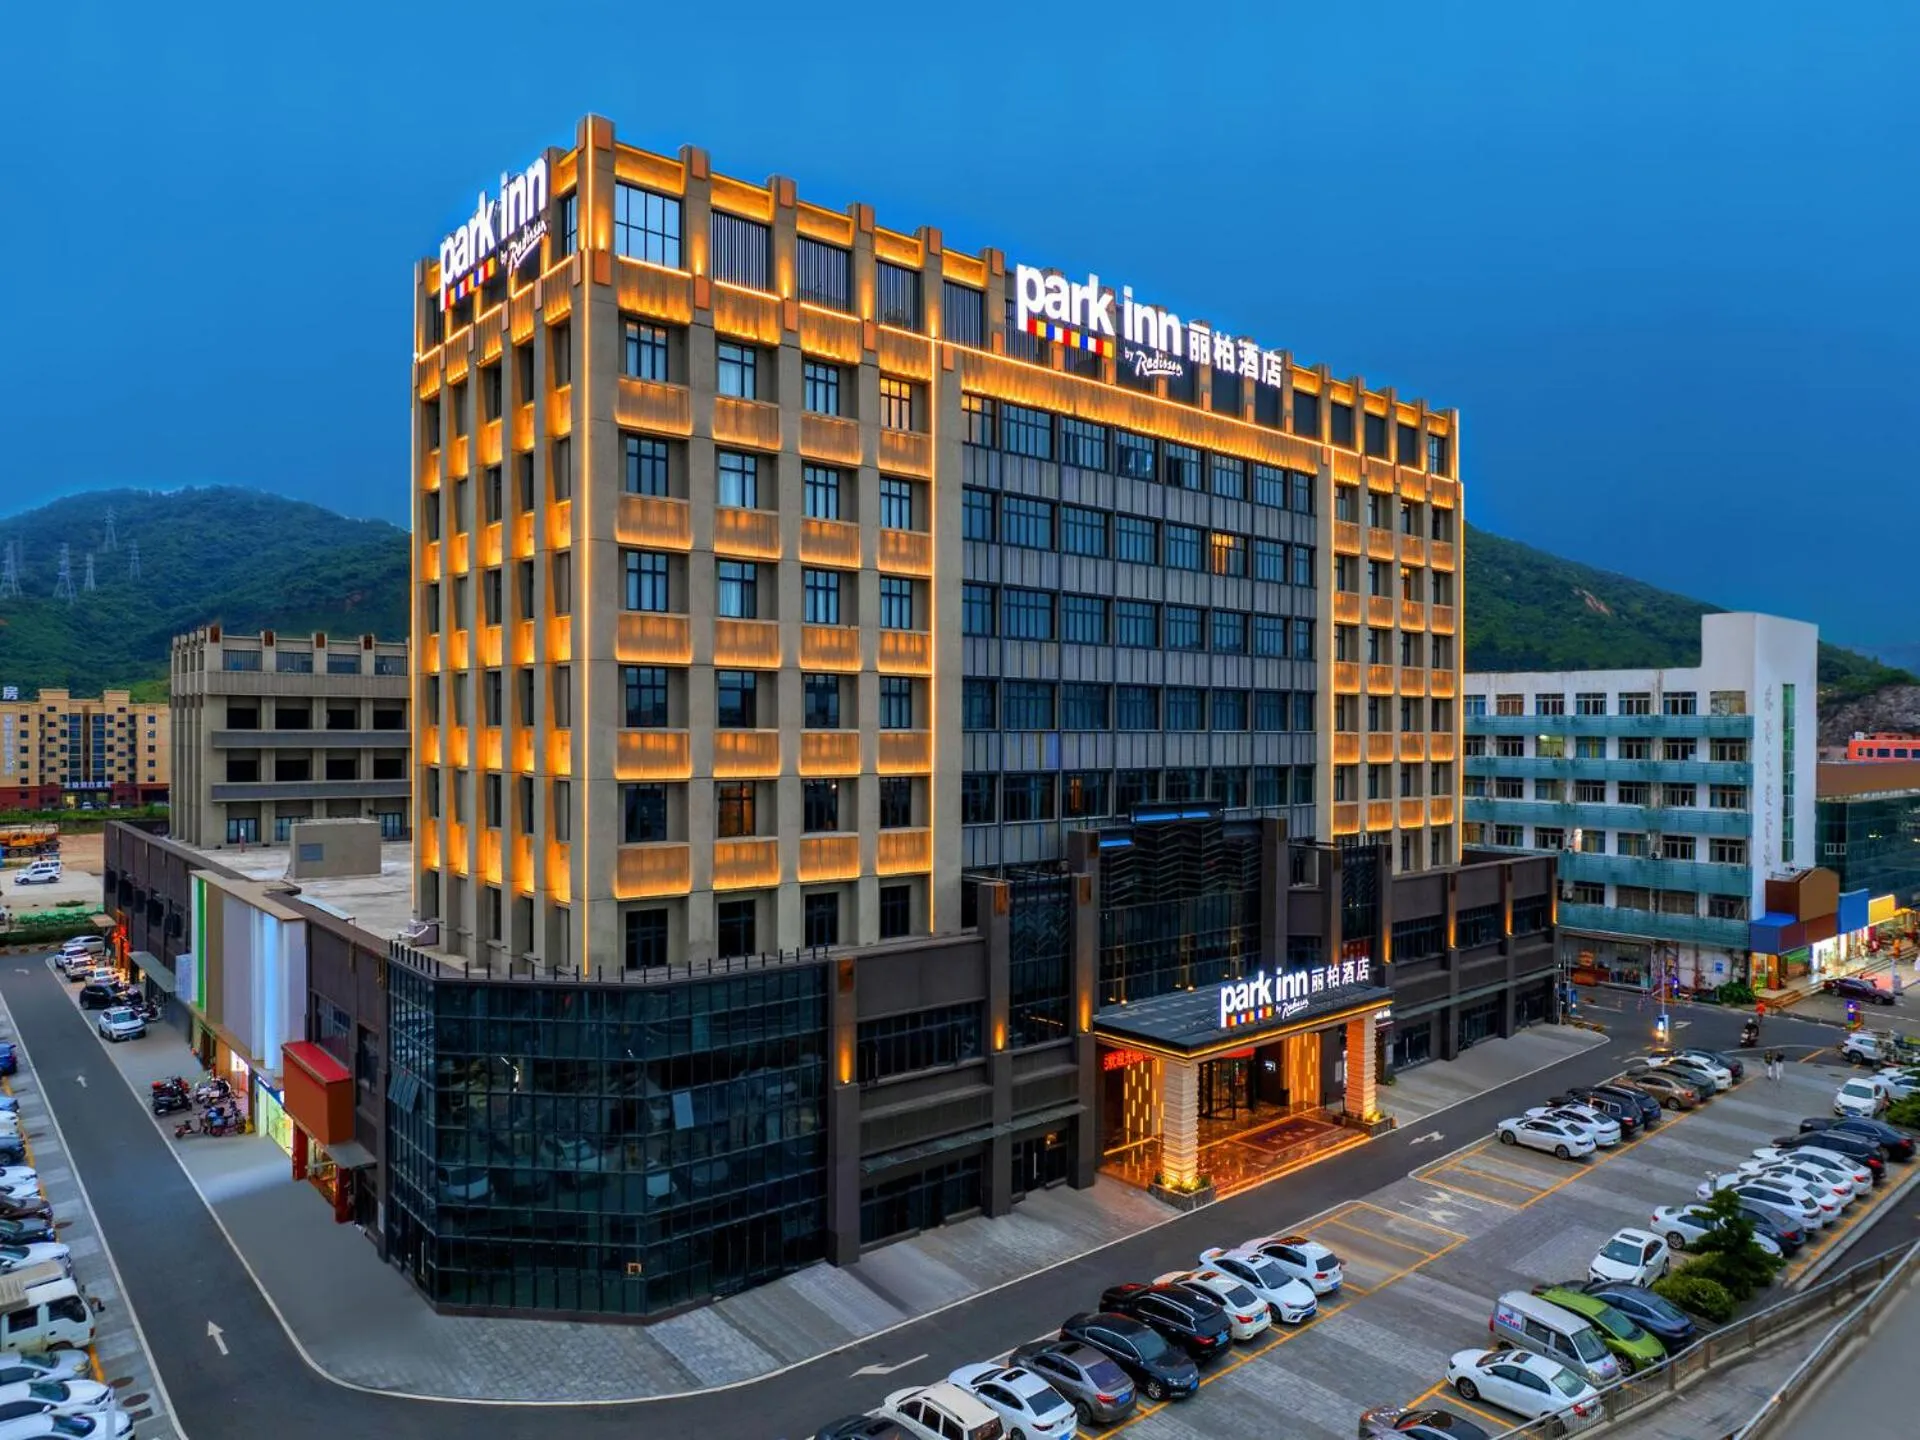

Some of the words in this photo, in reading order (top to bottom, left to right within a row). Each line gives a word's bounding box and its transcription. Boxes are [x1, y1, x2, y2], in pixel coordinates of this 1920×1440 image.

[440, 191, 497, 312] park
[500, 157, 548, 241] inn
[1017, 263, 1116, 337] park
[1123, 284, 1182, 357] inn
[1124, 346, 1134, 362] by
[1135, 349, 1184, 377] Radisson
[1188, 322, 1282, 389] 丽柏酒店
[1220, 970, 1272, 1029] park
[1275, 967, 1308, 1002] inn
[1311, 957, 1370, 994] 丽柏酒店
